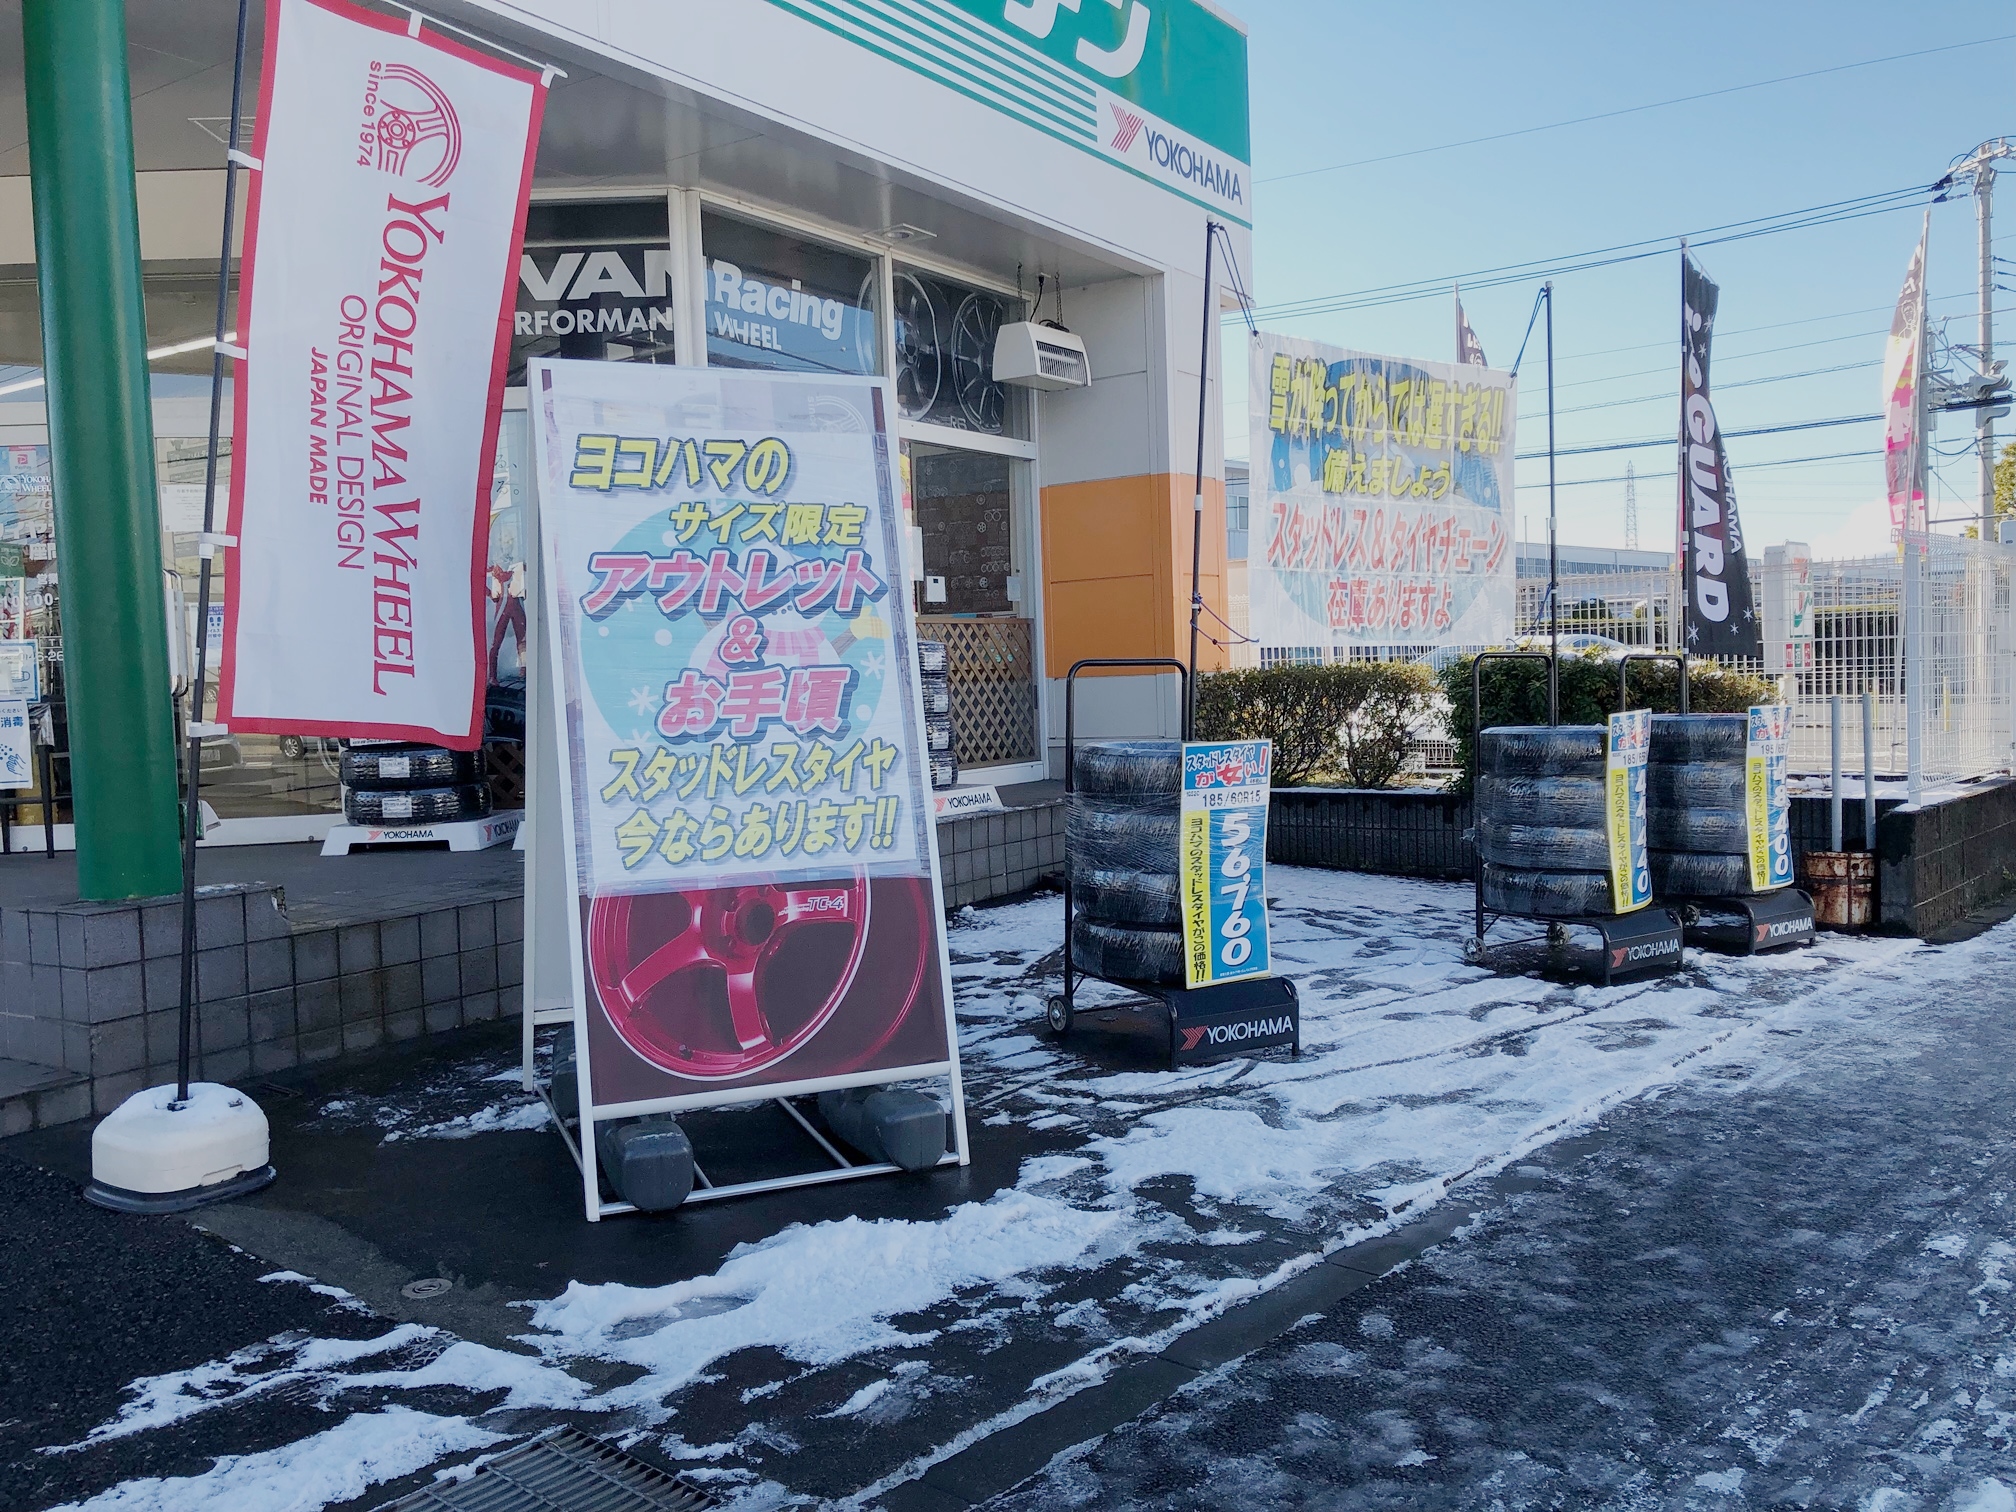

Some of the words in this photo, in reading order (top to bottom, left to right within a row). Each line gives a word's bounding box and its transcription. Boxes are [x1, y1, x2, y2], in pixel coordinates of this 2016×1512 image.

[362, 60, 384, 117] since
[356, 121, 376, 167] 1974
[1143, 125, 1244, 206] YOKOHAMA
[711, 259, 844, 341] Racing
[713, 311, 783, 351] WHEEL
[336, 294, 368, 446] ORIGINAL
[370, 191, 451, 490] YOKOHAMA
[309, 346, 329, 428] JAPAN
[309, 434, 328, 506] MADE
[569, 433, 793, 496] ヨコハマの
[1323, 448, 1453, 500] 備えましょう
[336, 456, 366, 570] DESIGN
[670, 501, 868, 546] サイズ限定
[1267, 502, 1507, 574] スタッドレス&タイヤチェーン
[372, 498, 421, 697] WHEEL
[579, 549, 889, 620] アウトレット
[1327, 577, 1453, 630] 在庫ありますよ
[718, 614, 769, 668] &
[655, 664, 860, 745] お手頃
[600, 737, 899, 802] スタッドレスタイヤ
[1186, 744, 1255, 772] スタッドレスタイヤ
[946, 791, 993, 809] YOKOHAMA
[1202, 789, 1261, 808] 185/60R15
[383, 829, 434, 840] YOKOHAMA
[615, 795, 899, 870] 今ならあります!!
[1220, 812, 1252, 967] 56,760
[1627, 938, 1680, 962] YOKOHAMA
[1769, 916, 1814, 938] YOKOHAMA
[1207, 1015, 1294, 1045] YOKOHAMA
